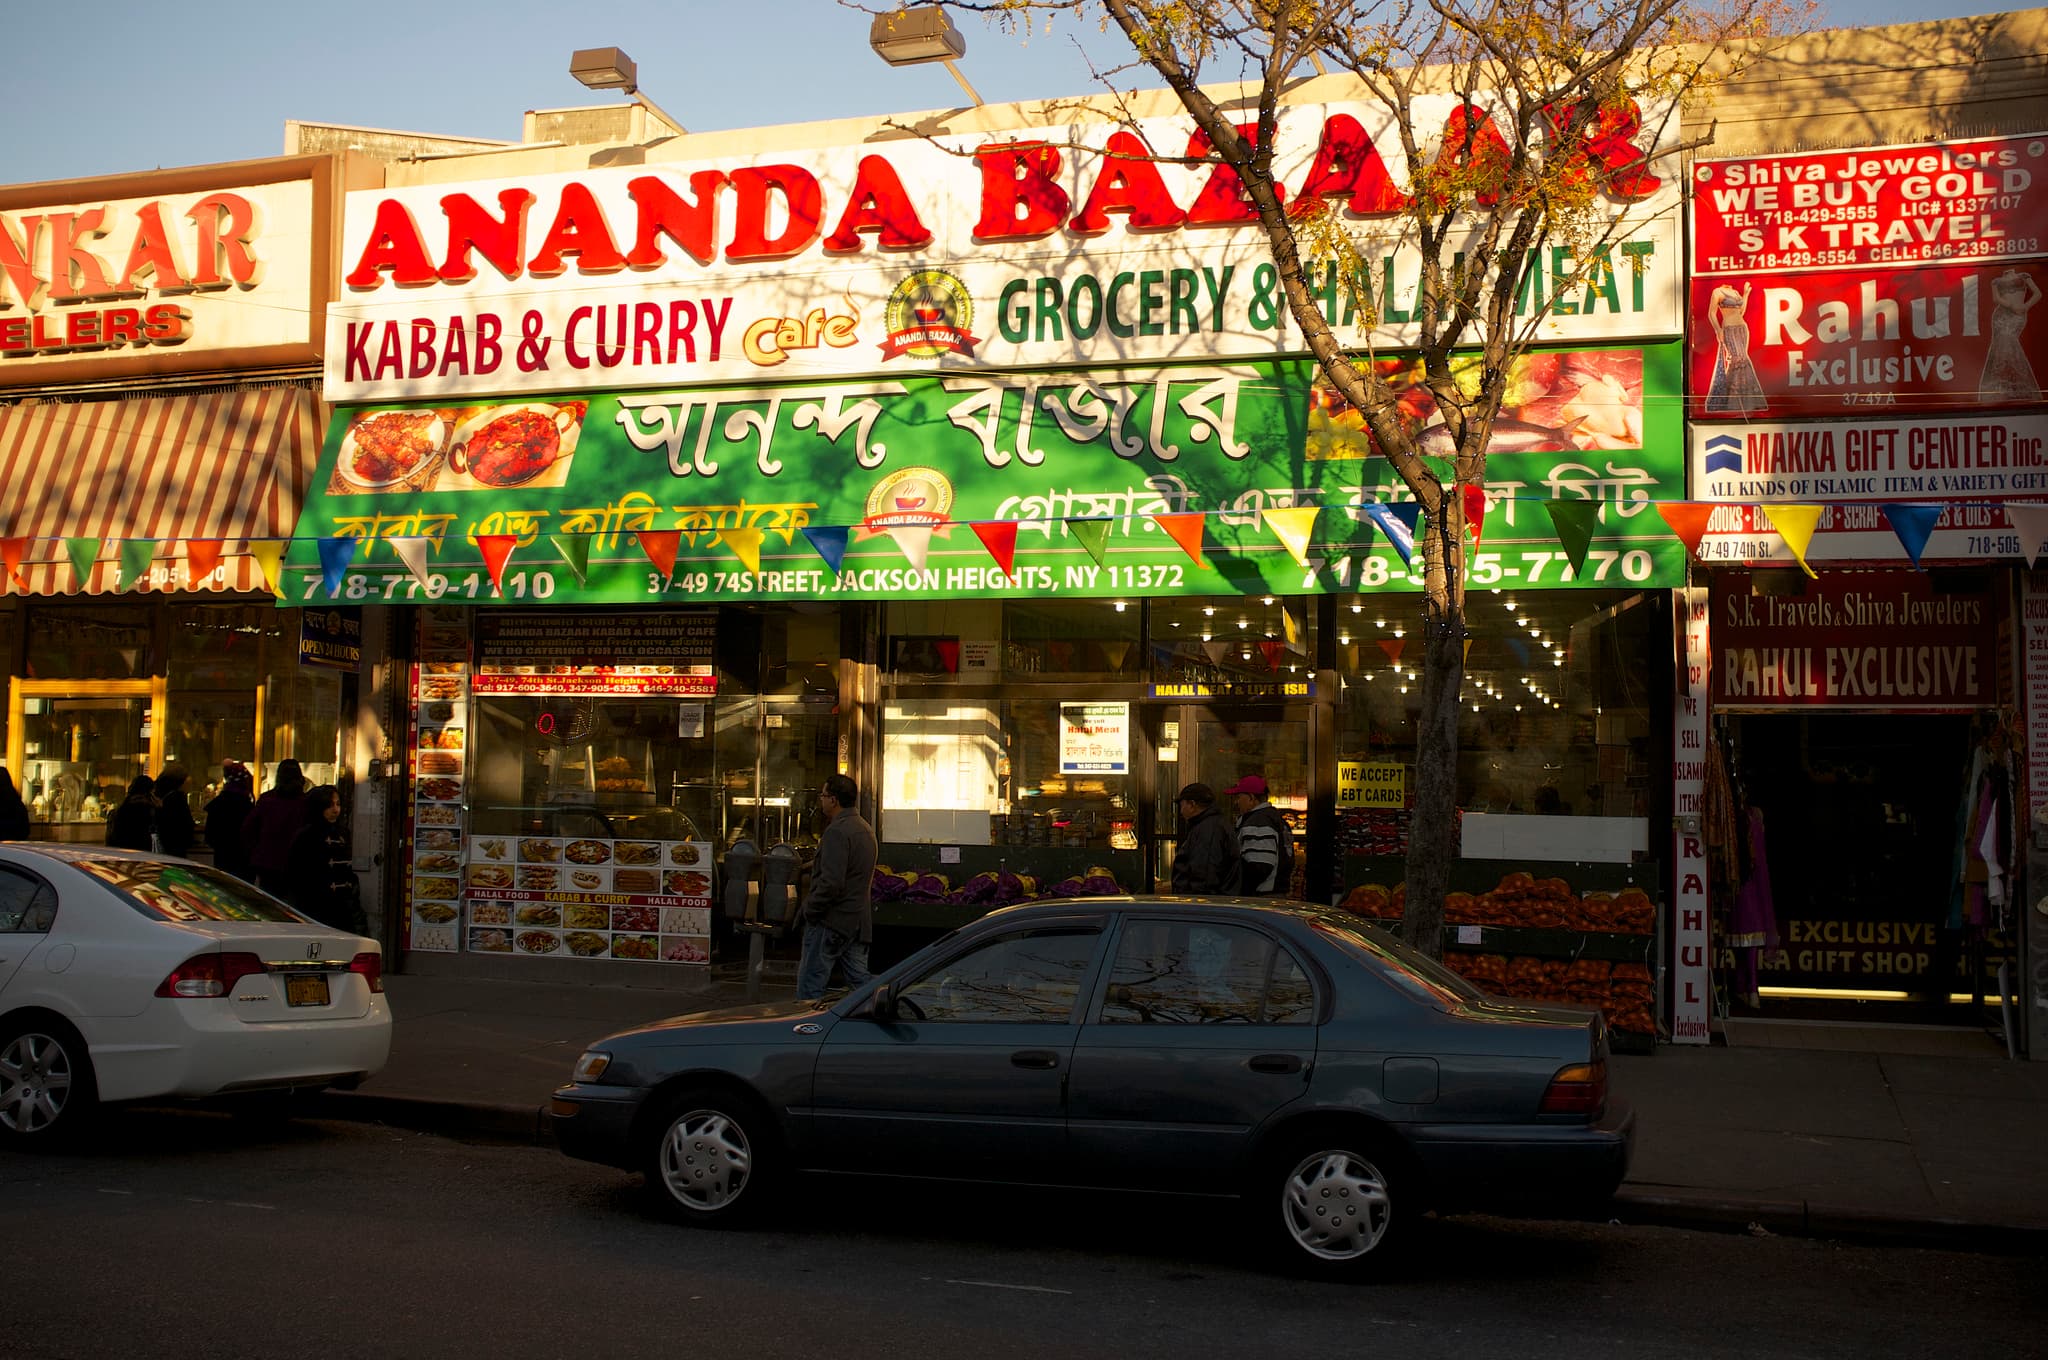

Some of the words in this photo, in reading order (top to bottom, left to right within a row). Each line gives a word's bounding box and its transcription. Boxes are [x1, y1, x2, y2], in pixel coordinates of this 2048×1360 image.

[1724, 162, 1825, 187] Shiva
[1837, 146, 2018, 180] Jewelers
[346, 153, 936, 289] ANANDA
[974, 95, 1662, 241] BAZAAR
[1712, 187, 1779, 213] WE
[1793, 179, 1886, 209] BUY
[1900, 169, 2032, 200] GOLD
[1722, 212, 1759, 228] TEL:
[1763, 205, 1877, 225] 718-429-5555
[1900, 201, 1941, 217] LIC#
[1944, 195, 2021, 214] 1337107
[1738, 228, 1764, 253] S
[1778, 225, 1808, 250] K
[1820, 215, 2005, 247] TRAVEL
[1708, 256, 1744, 271] TEL:
[1747, 249, 1857, 268] 718-429-5554
[1870, 247, 1918, 262] CELL:
[1921, 238, 2038, 259] 646-239-8803
[998, 264, 1234, 344] GROCERY
[1249, 261, 1288, 330] &
[1763, 274, 1982, 347] Rahul
[344, 313, 502, 383] KABAB
[516, 310, 552, 373] &
[565, 297, 733, 370] CURRY
[743, 305, 860, 367] Cafe
[895, 331, 927, 347] ANANDA
[1787, 346, 1955, 387] Exclusive
[1842, 392, 1882, 406] 37-49
[1885, 391, 1897, 405] A
[615, 381, 910, 478] আনন্দ
[941, 364, 1262, 468] বাজার
[1747, 430, 1836, 474] MAKKA
[1845, 428, 1899, 472] GIFT
[1908, 425, 2008, 471] CENTER
[2011, 431, 2048, 468] inc.
[1708, 481, 1735, 498] ALL
[1739, 479, 1786, 497] KINDS
[1789, 479, 1811, 495] OF
[1814, 478, 1877, 495] ISLAMIC
[1884, 476, 1923, 492] ITEM
[1927, 474, 1938, 491] &
[1940, 474, 2007, 491] VARIETY
[1966, 499, 1992, 527] OILS
[1697, 541, 1729, 561] 37-49
[1732, 540, 1756, 559] 74th
[1758, 539, 1772, 558] St.
[647, 572, 708, 594] 37-49
[831, 567, 941, 593] JACKSON
[946, 566, 1059, 594] HEIGHTS,
[1065, 566, 1098, 589] NY
[1107, 564, 1184, 588] 11372
[1727, 593, 1761, 628] S.k.
[1764, 594, 1832, 627] Travels
[1833, 612, 1841, 627] &
[1844, 592, 1895, 626] Shiva
[1898, 592, 1981, 625] Jewelers
[484, 646, 505, 656] WE
[506, 646, 523, 656] DO
[1724, 647, 1818, 697] RAHUL
[1826, 646, 1980, 697] EXCLUSIVE
[1155, 684, 1196, 697] HALAL
[1197, 684, 1232, 697] MEAT
[1277, 683, 1308, 696] FISH
[1684, 699, 1697, 716] WE
[1682, 730, 1700, 748] SELL
[1341, 768, 1357, 781] WE
[1359, 768, 1402, 782] ACCEPT
[1341, 788, 1362, 802] EBT
[1364, 789, 1402, 803] CARDS
[474, 890, 503, 900] HALAL
[505, 891, 531, 900] FOOD
[544, 892, 581, 903] KABAB
[583, 893, 592, 904] &
[593, 894, 631, 905] CURRY
[647, 896, 680, 906] HALAL
[681, 897, 707, 907] FOOD
[1682, 838, 1705, 1004] RAHUL
[1789, 920, 1937, 946] EXCLUSIVE
[1797, 950, 1857, 974] GIFT
[1861, 950, 1930, 975] SHOP
[1676, 1014, 1707, 1038] Exclusive
